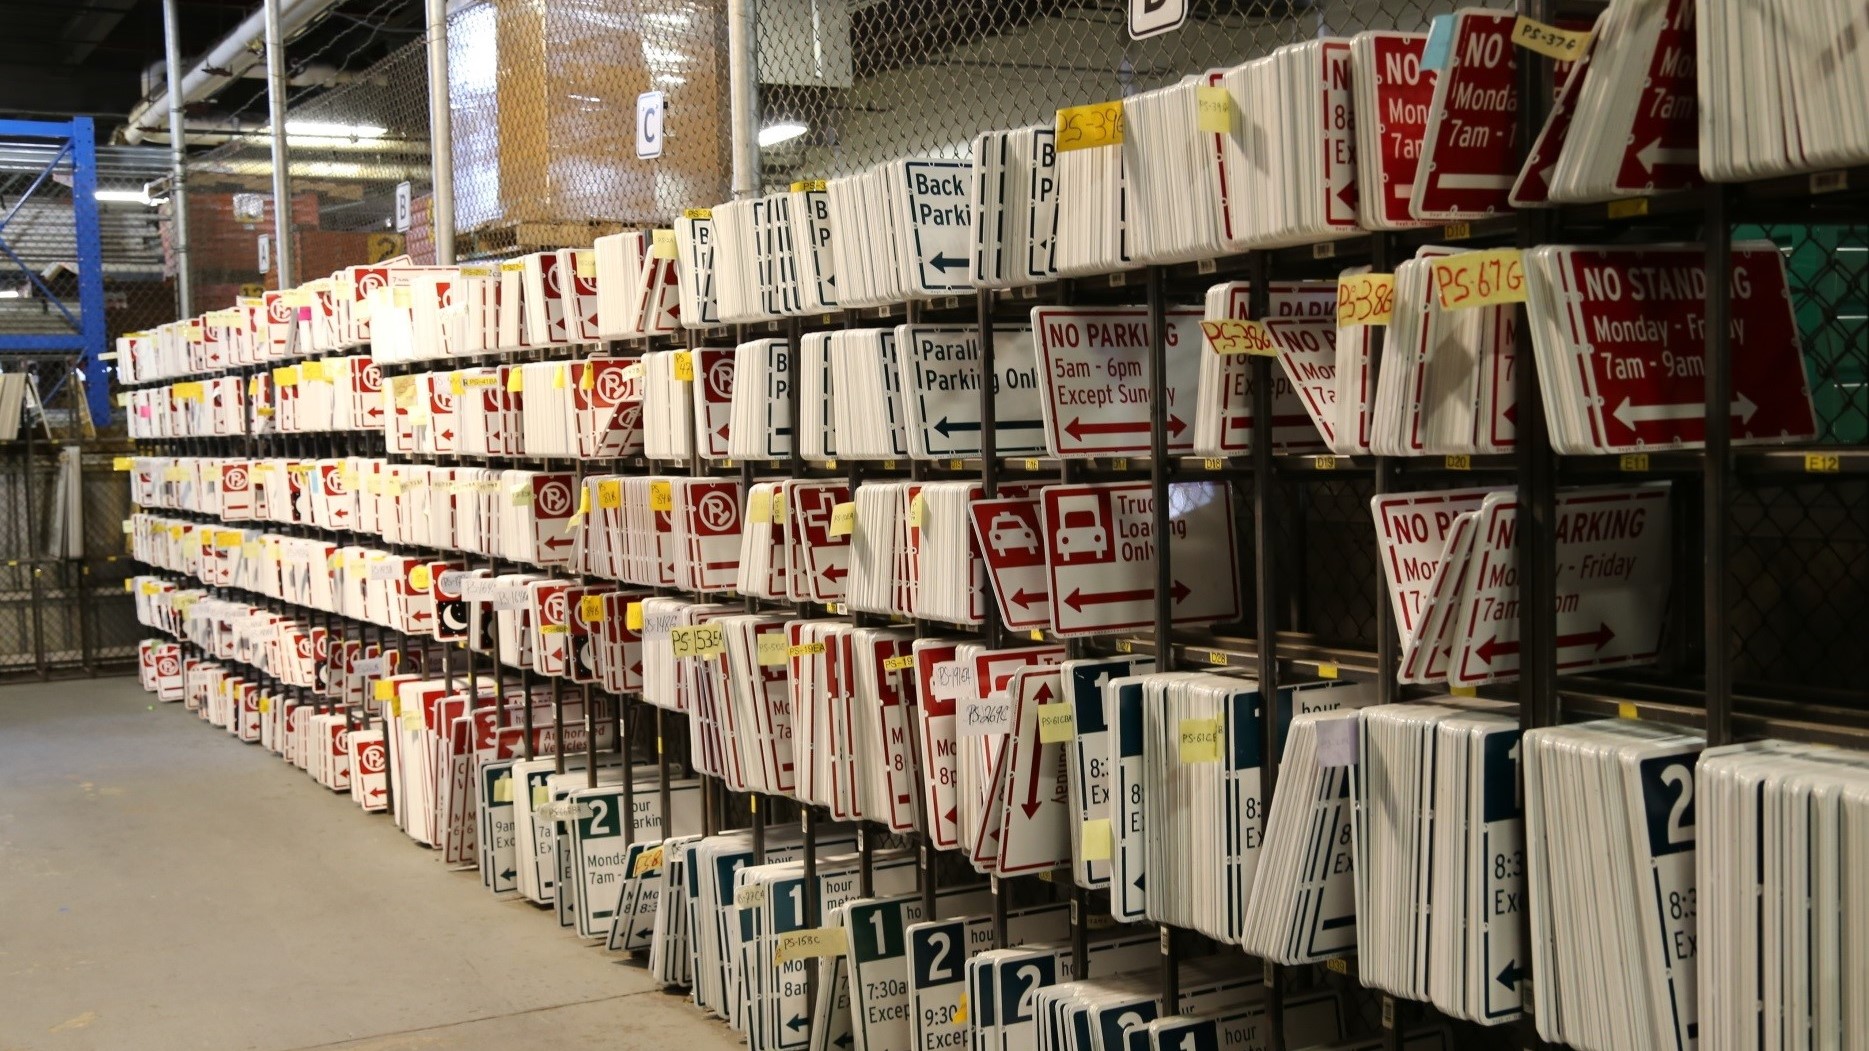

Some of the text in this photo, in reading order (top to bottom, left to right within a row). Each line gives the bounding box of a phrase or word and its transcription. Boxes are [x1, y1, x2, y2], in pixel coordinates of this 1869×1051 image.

[1464, 33, 1503, 70] NO
[1385, 52, 1421, 85] NO
[643, 107, 656, 144] C
[915, 173, 965, 196] Back
[1583, 266, 1752, 302] NO STANDG
[1049, 322, 1179, 349] NO PARKIG
[1281, 330, 1320, 353] NO
[1592, 314, 1669, 348] Monday
[1055, 357, 1091, 379] 5am
[1107, 357, 1142, 381] 6pm
[1600, 351, 1646, 380] 7am
[1662, 350, 1706, 378] 9am
[925, 367, 1040, 395] Parkig Onl
[1057, 384, 1176, 409] Except Suny
[1206, 458, 1221, 469] D18
[1317, 457, 1334, 469] D19
[1447, 455, 1467, 469] D20
[1809, 456, 1837, 471] E12
[1118, 518, 1187, 541] Loang
[1392, 512, 1429, 545] NO
[1555, 508, 1646, 544] ARKING
[1580, 554, 1637, 580] Friday
[589, 799, 611, 836] 2
[1660, 763, 1696, 845] 2
[589, 871, 615, 885] 7am
[826, 879, 853, 895] hour
[789, 884, 803, 927] 1
[869, 909, 886, 956] 1
[927, 931, 952, 981] 2
[1016, 964, 1041, 1018] 2
[1224, 1023, 1257, 1045] hour
